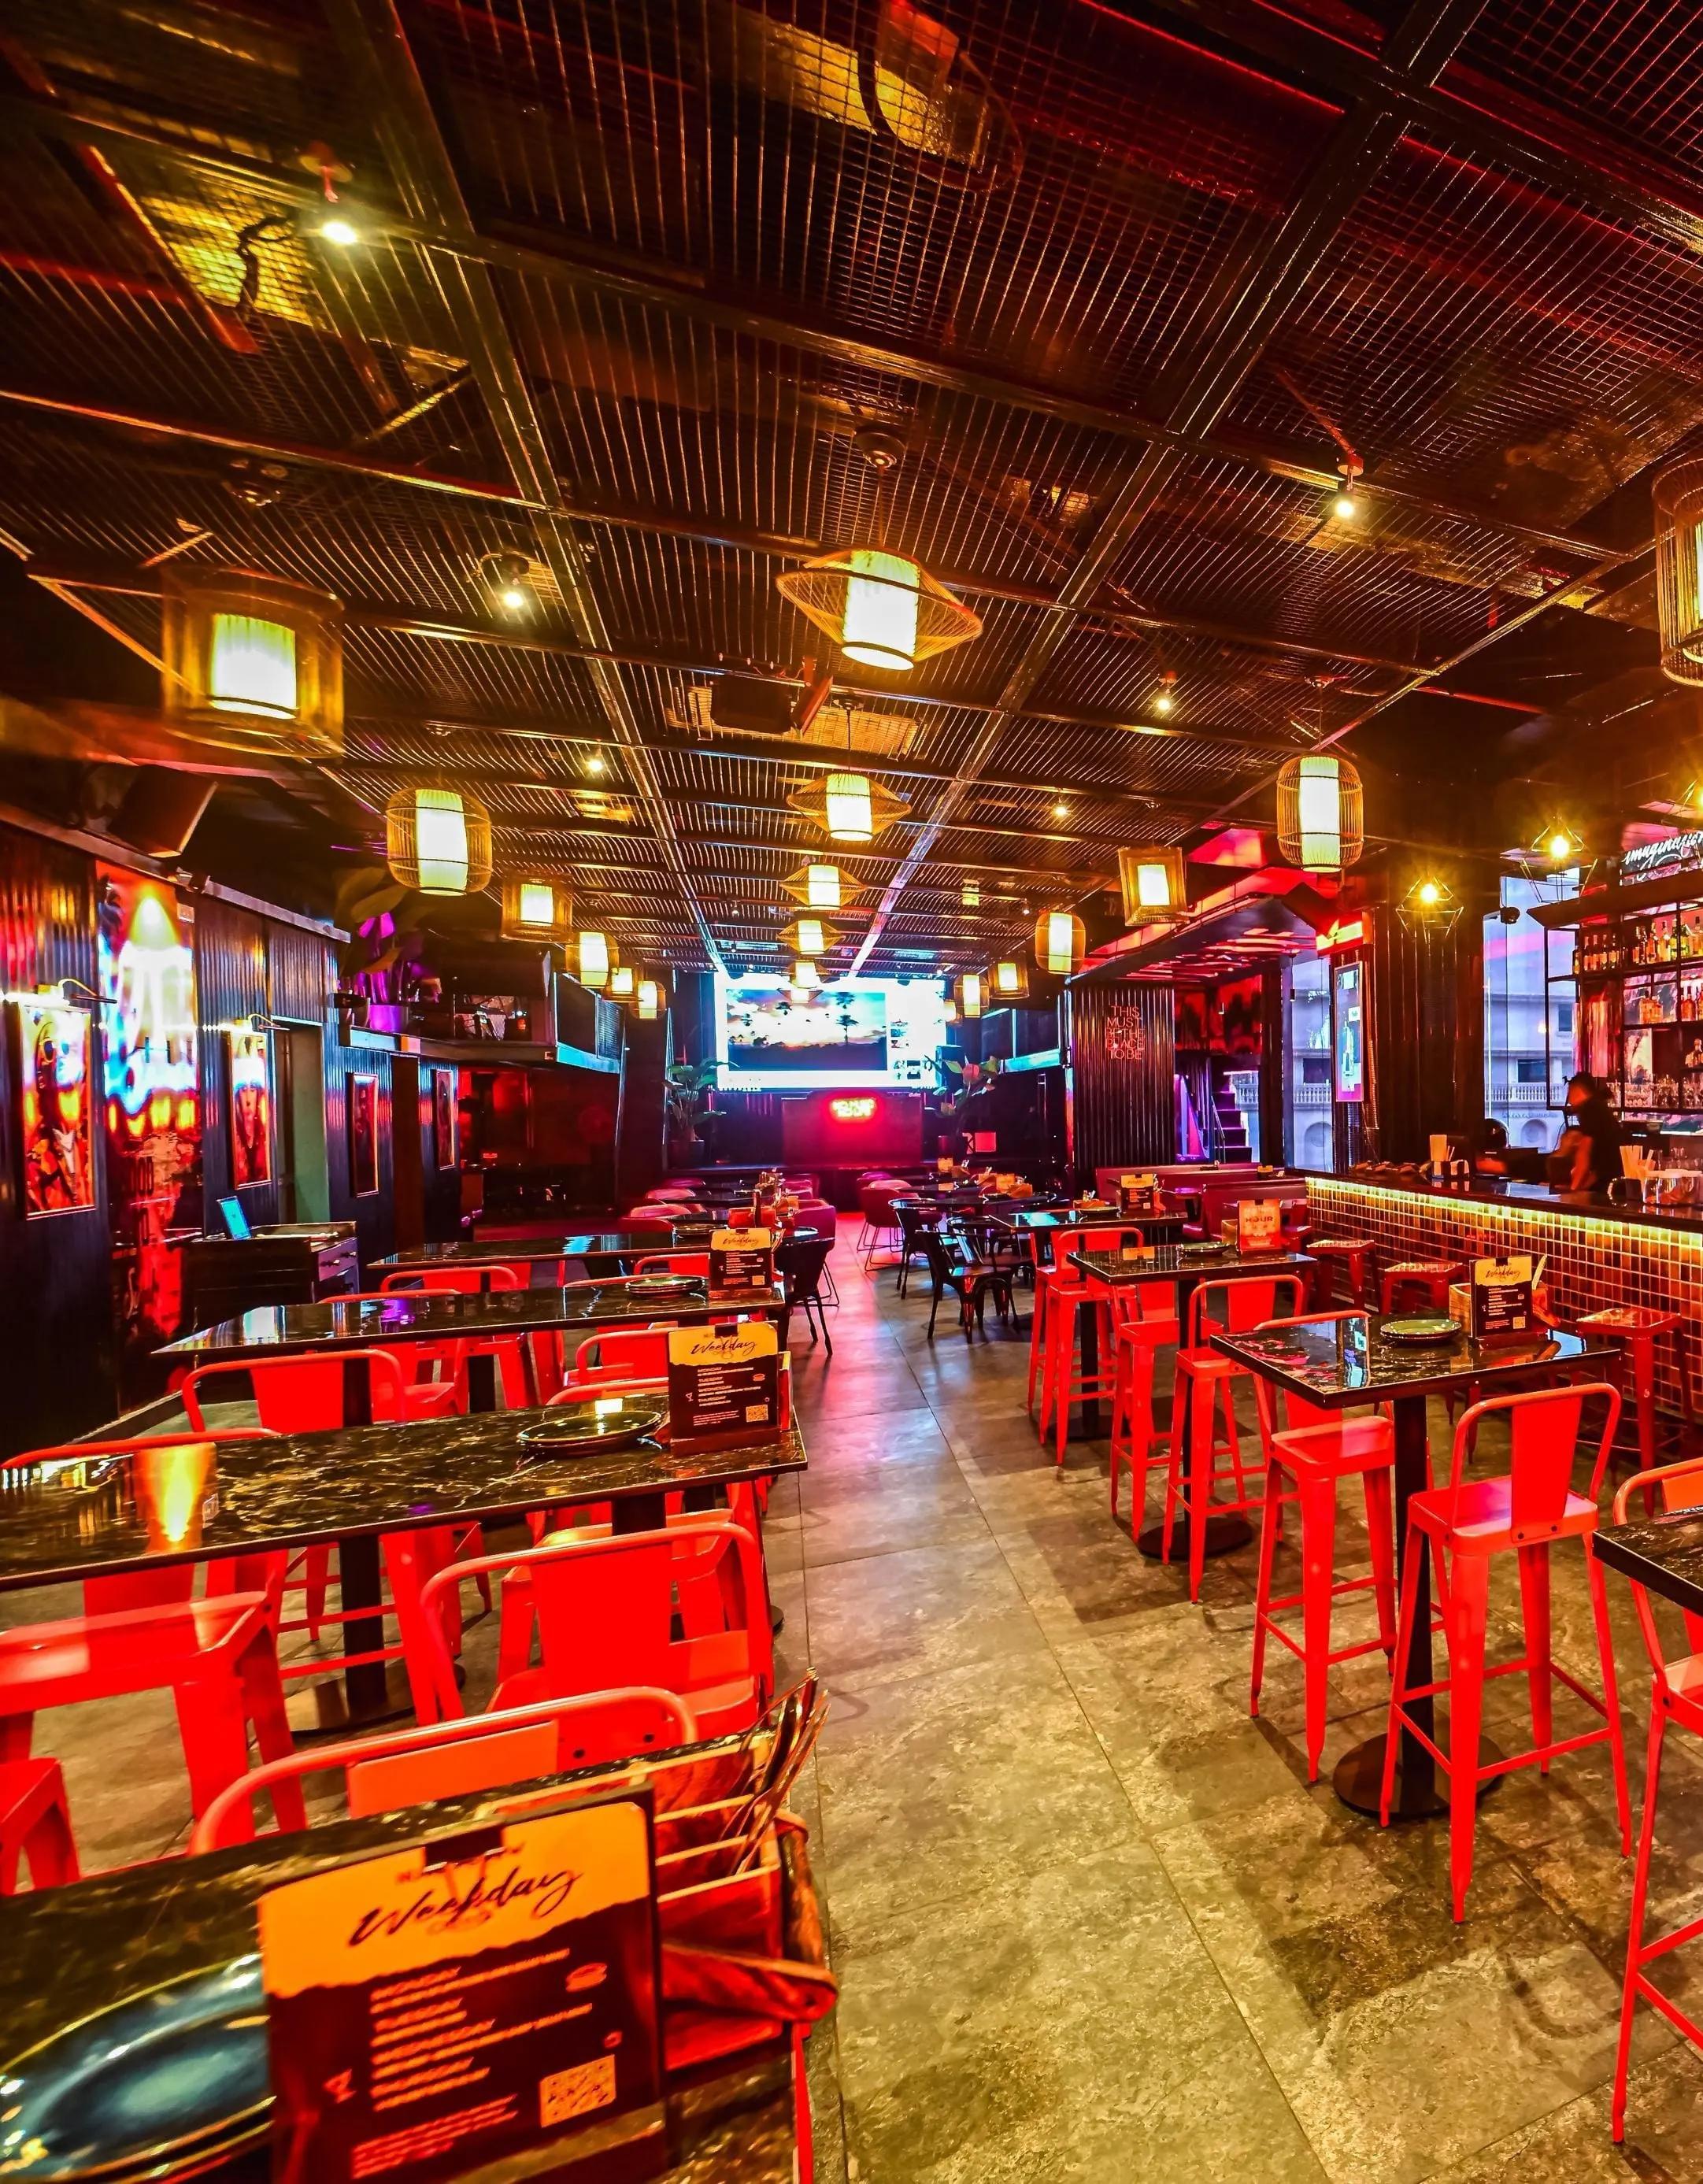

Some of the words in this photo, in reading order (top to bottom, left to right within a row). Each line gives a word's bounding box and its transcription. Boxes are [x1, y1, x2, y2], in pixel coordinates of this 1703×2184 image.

[1111, 1005, 1140, 1018] THIS
[1107, 1016, 1143, 1028] MUST
[1105, 1027, 1120, 1038] BE
[1121, 1027, 1146, 1038] THE
[1105, 1038, 1146, 1050] PLACE
[1109, 1049, 1124, 1060] TO
[1127, 1049, 1142, 1060] BE
[690, 1338, 757, 1357] Weekday
[349, 1865, 584, 1948] Weekday
